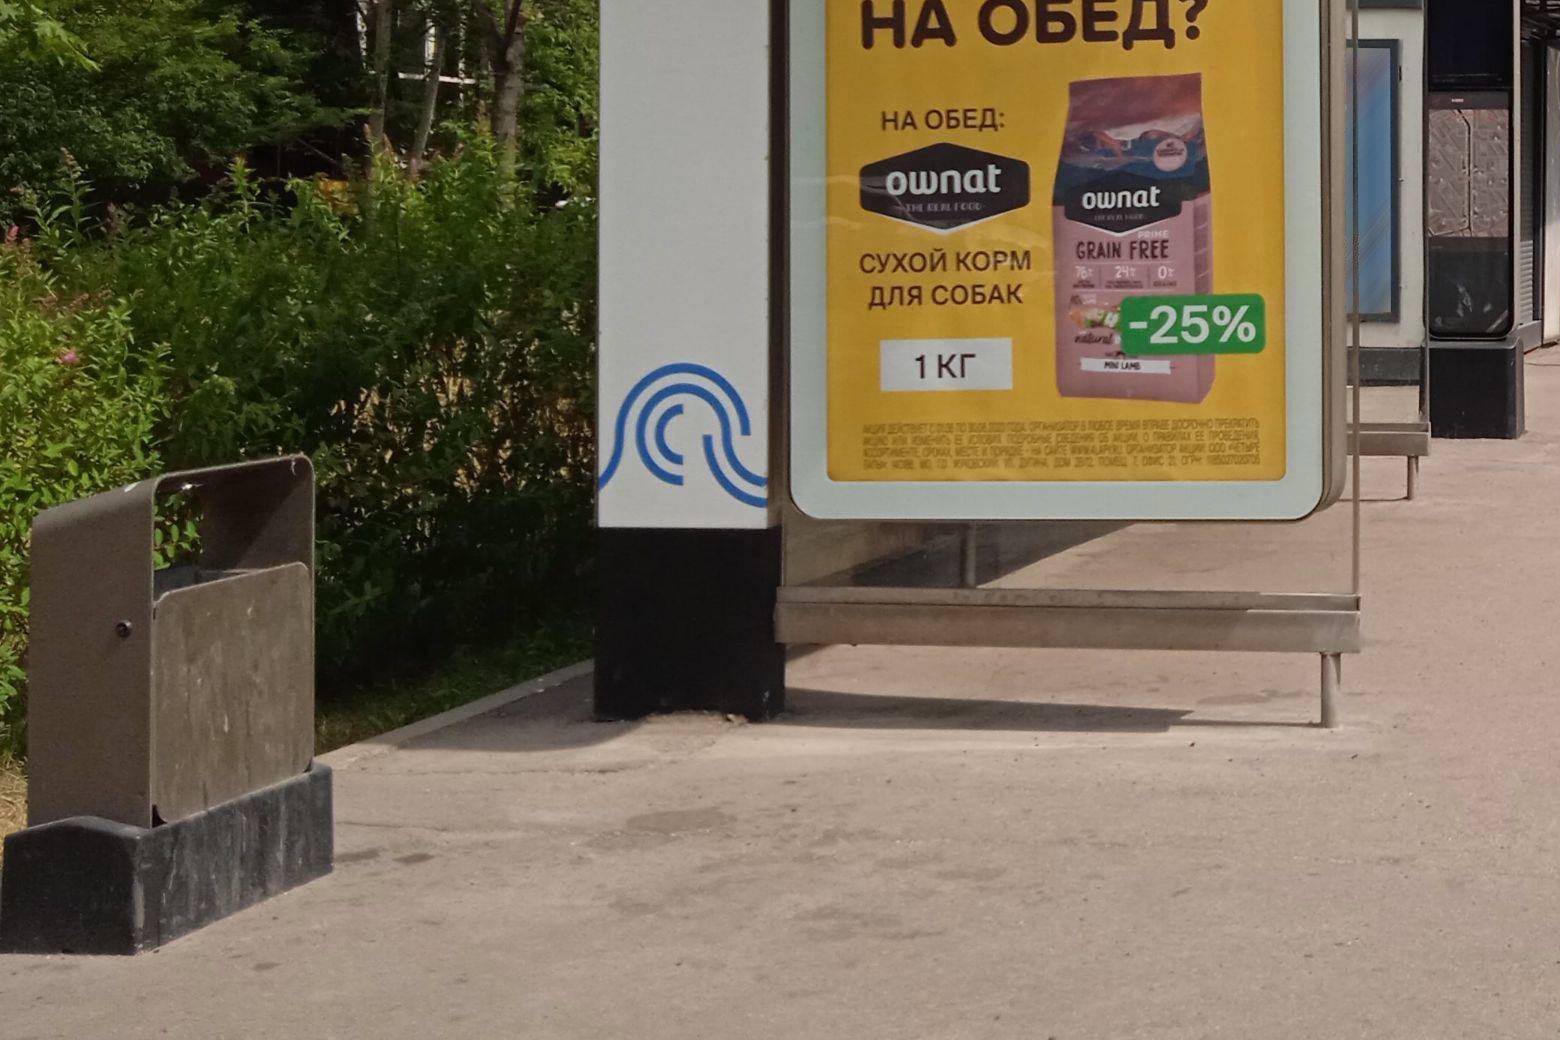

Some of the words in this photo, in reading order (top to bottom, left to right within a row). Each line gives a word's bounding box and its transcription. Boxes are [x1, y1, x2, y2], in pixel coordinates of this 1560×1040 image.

[881, 111, 916, 130] НА
[925, 108, 1005, 131] ОБЕД:
[886, 164, 1002, 195] ownat
[1082, 186, 1160, 209] ownat
[860, 247, 948, 274] СУХОЙ
[956, 249, 1031, 272] КОРМ
[1076, 240, 1121, 259] GRAIN
[1130, 240, 1169, 259] FREE
[868, 285, 923, 309] ДЛЯ
[930, 282, 1023, 306] СОБАК
[1128, 304, 1257, 345] -25%
[914, 356, 925, 379] 1
[937, 353, 976, 379] КГ
